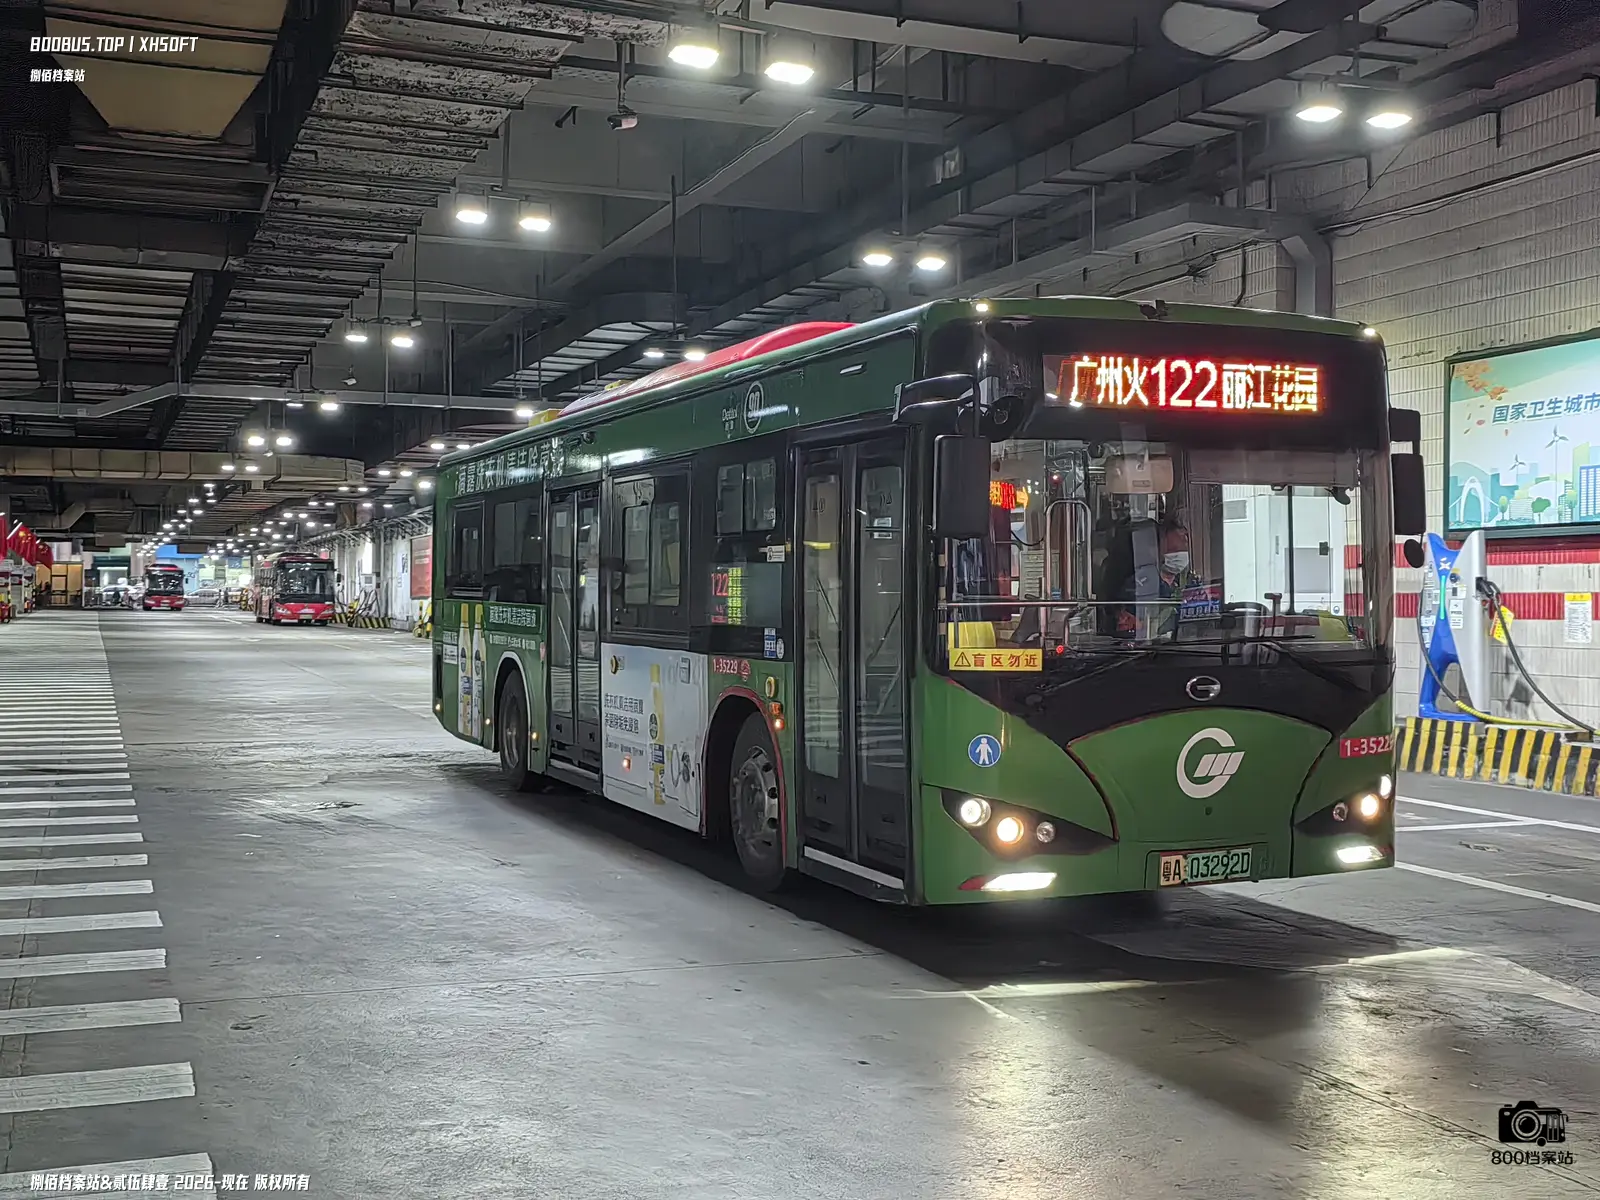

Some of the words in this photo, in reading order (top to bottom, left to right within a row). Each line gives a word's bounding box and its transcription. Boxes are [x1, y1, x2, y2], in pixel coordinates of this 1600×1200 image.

[1492, 393, 1600, 424] 国家卫生城市
[711, 573, 729, 597] 122
[972, 653, 1037, 668] 盲区勿近
